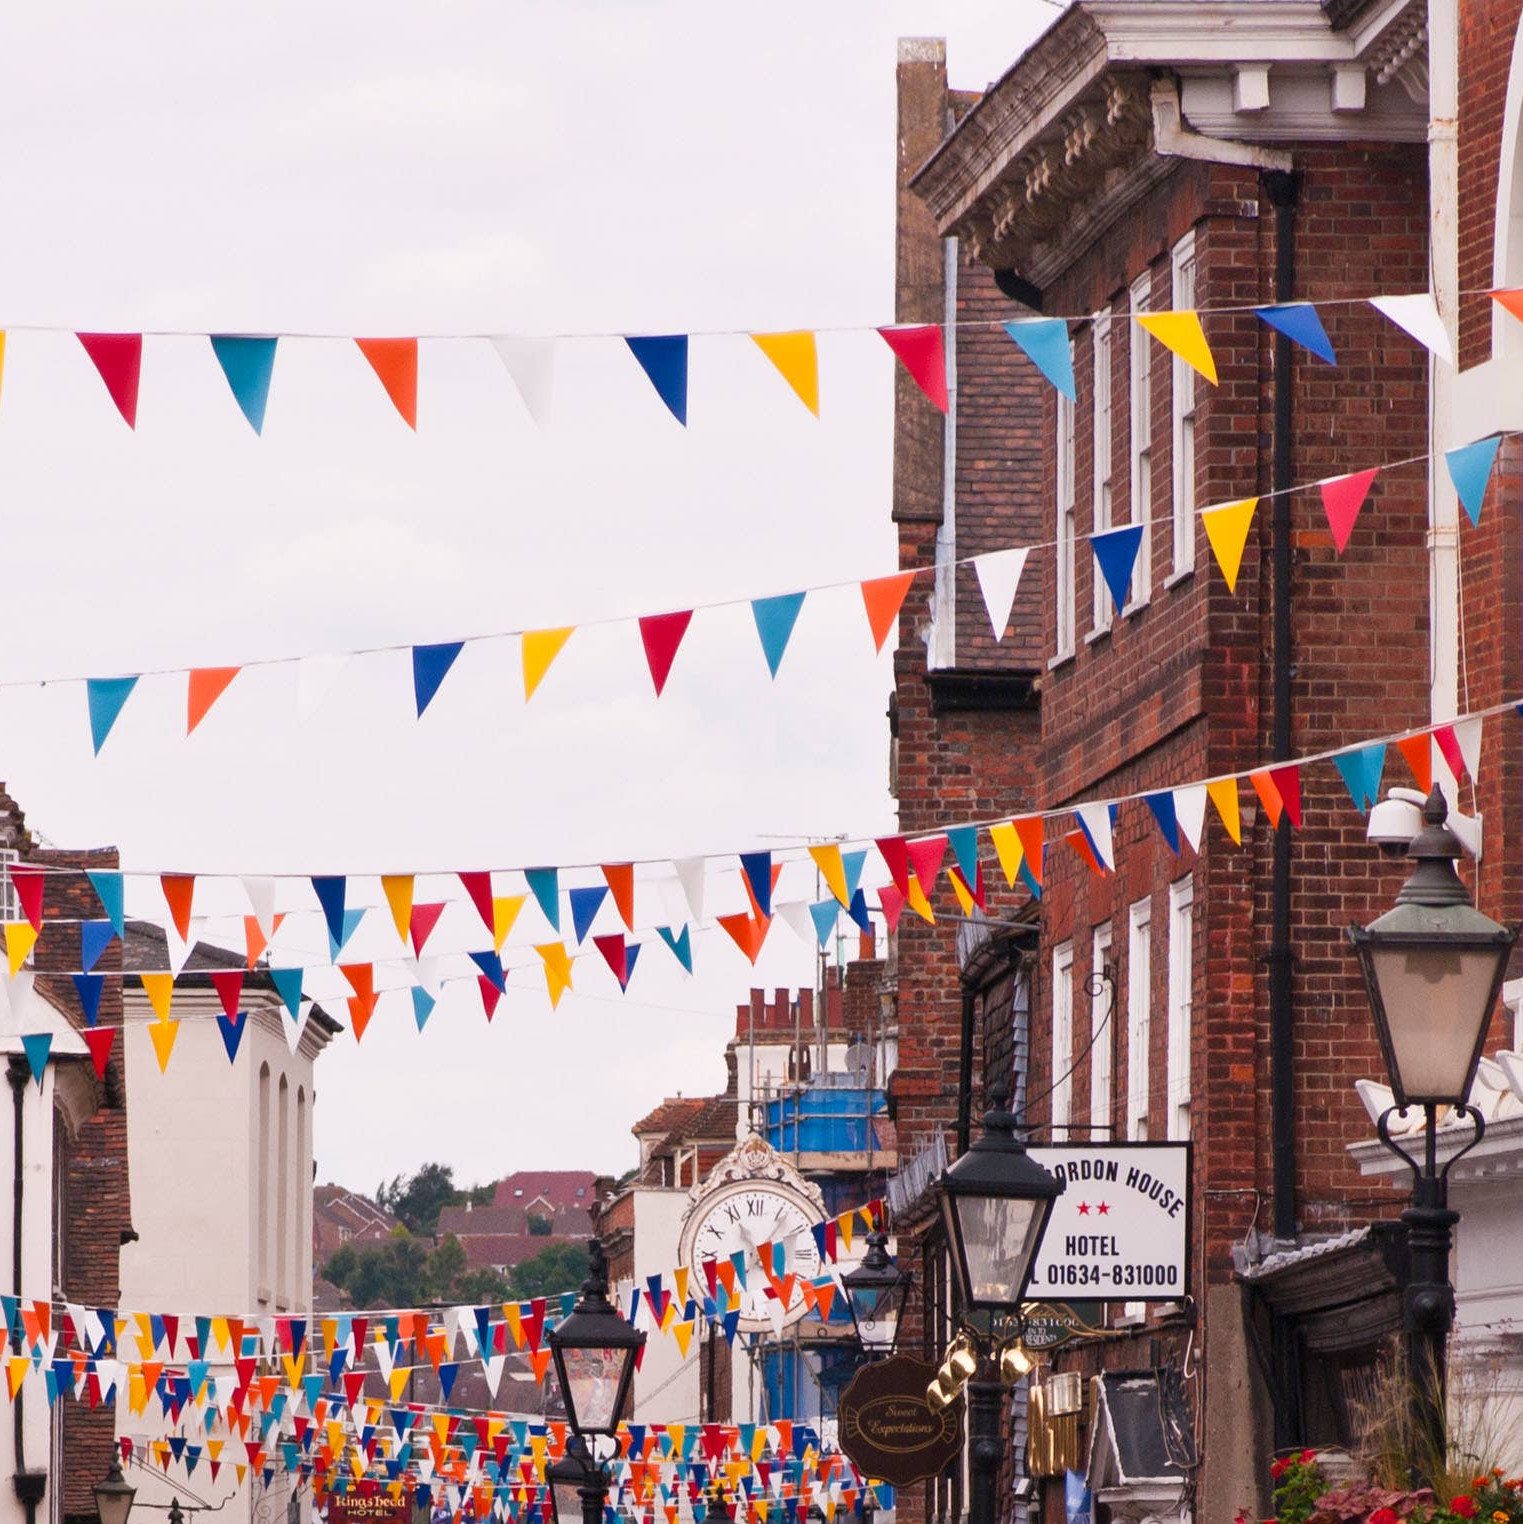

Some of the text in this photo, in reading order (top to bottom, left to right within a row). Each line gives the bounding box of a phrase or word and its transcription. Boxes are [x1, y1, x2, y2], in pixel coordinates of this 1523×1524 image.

[1050, 1159, 1184, 1218] ORDON HOUSE
[1066, 1235, 1119, 1256] HOTEL
[1048, 1264, 1177, 1285] 01634-831000
[885, 1405, 917, 1417] Sweet
[868, 1420, 933, 1438] Expectations
